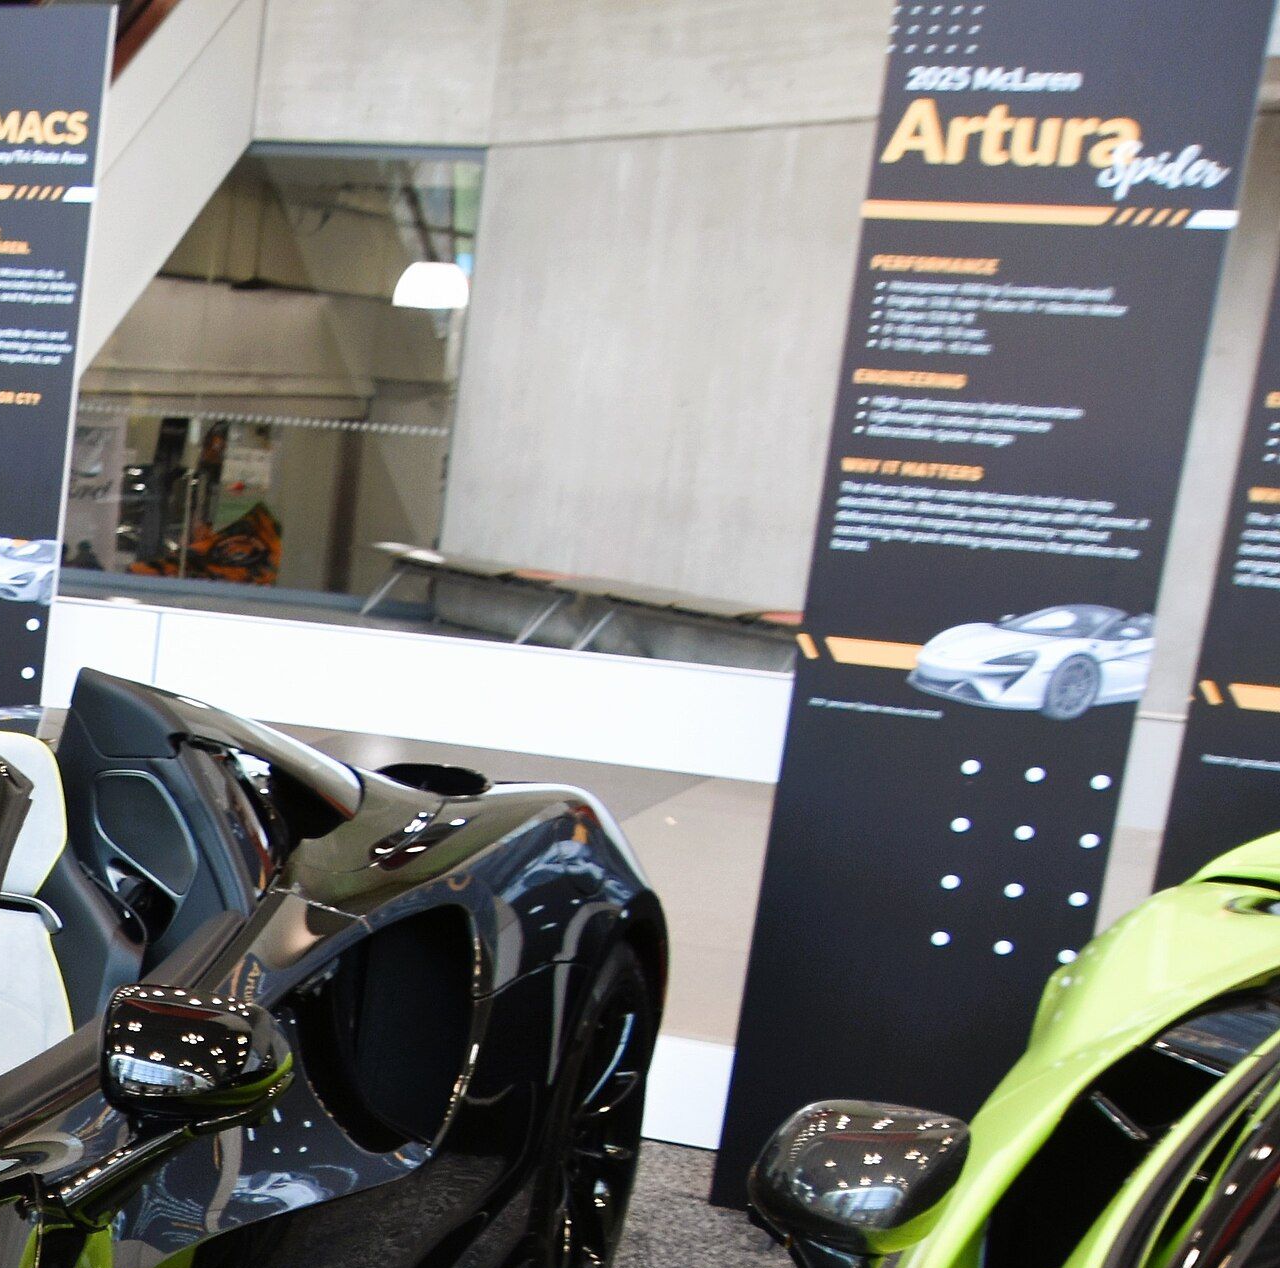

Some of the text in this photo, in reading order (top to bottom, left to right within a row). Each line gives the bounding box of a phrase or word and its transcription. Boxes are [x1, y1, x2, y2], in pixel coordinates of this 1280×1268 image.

[905, 65, 1083, 93] 2025 McLaren
[879, 97, 1140, 169] Artura
[1095, 140, 1232, 201] Spider
